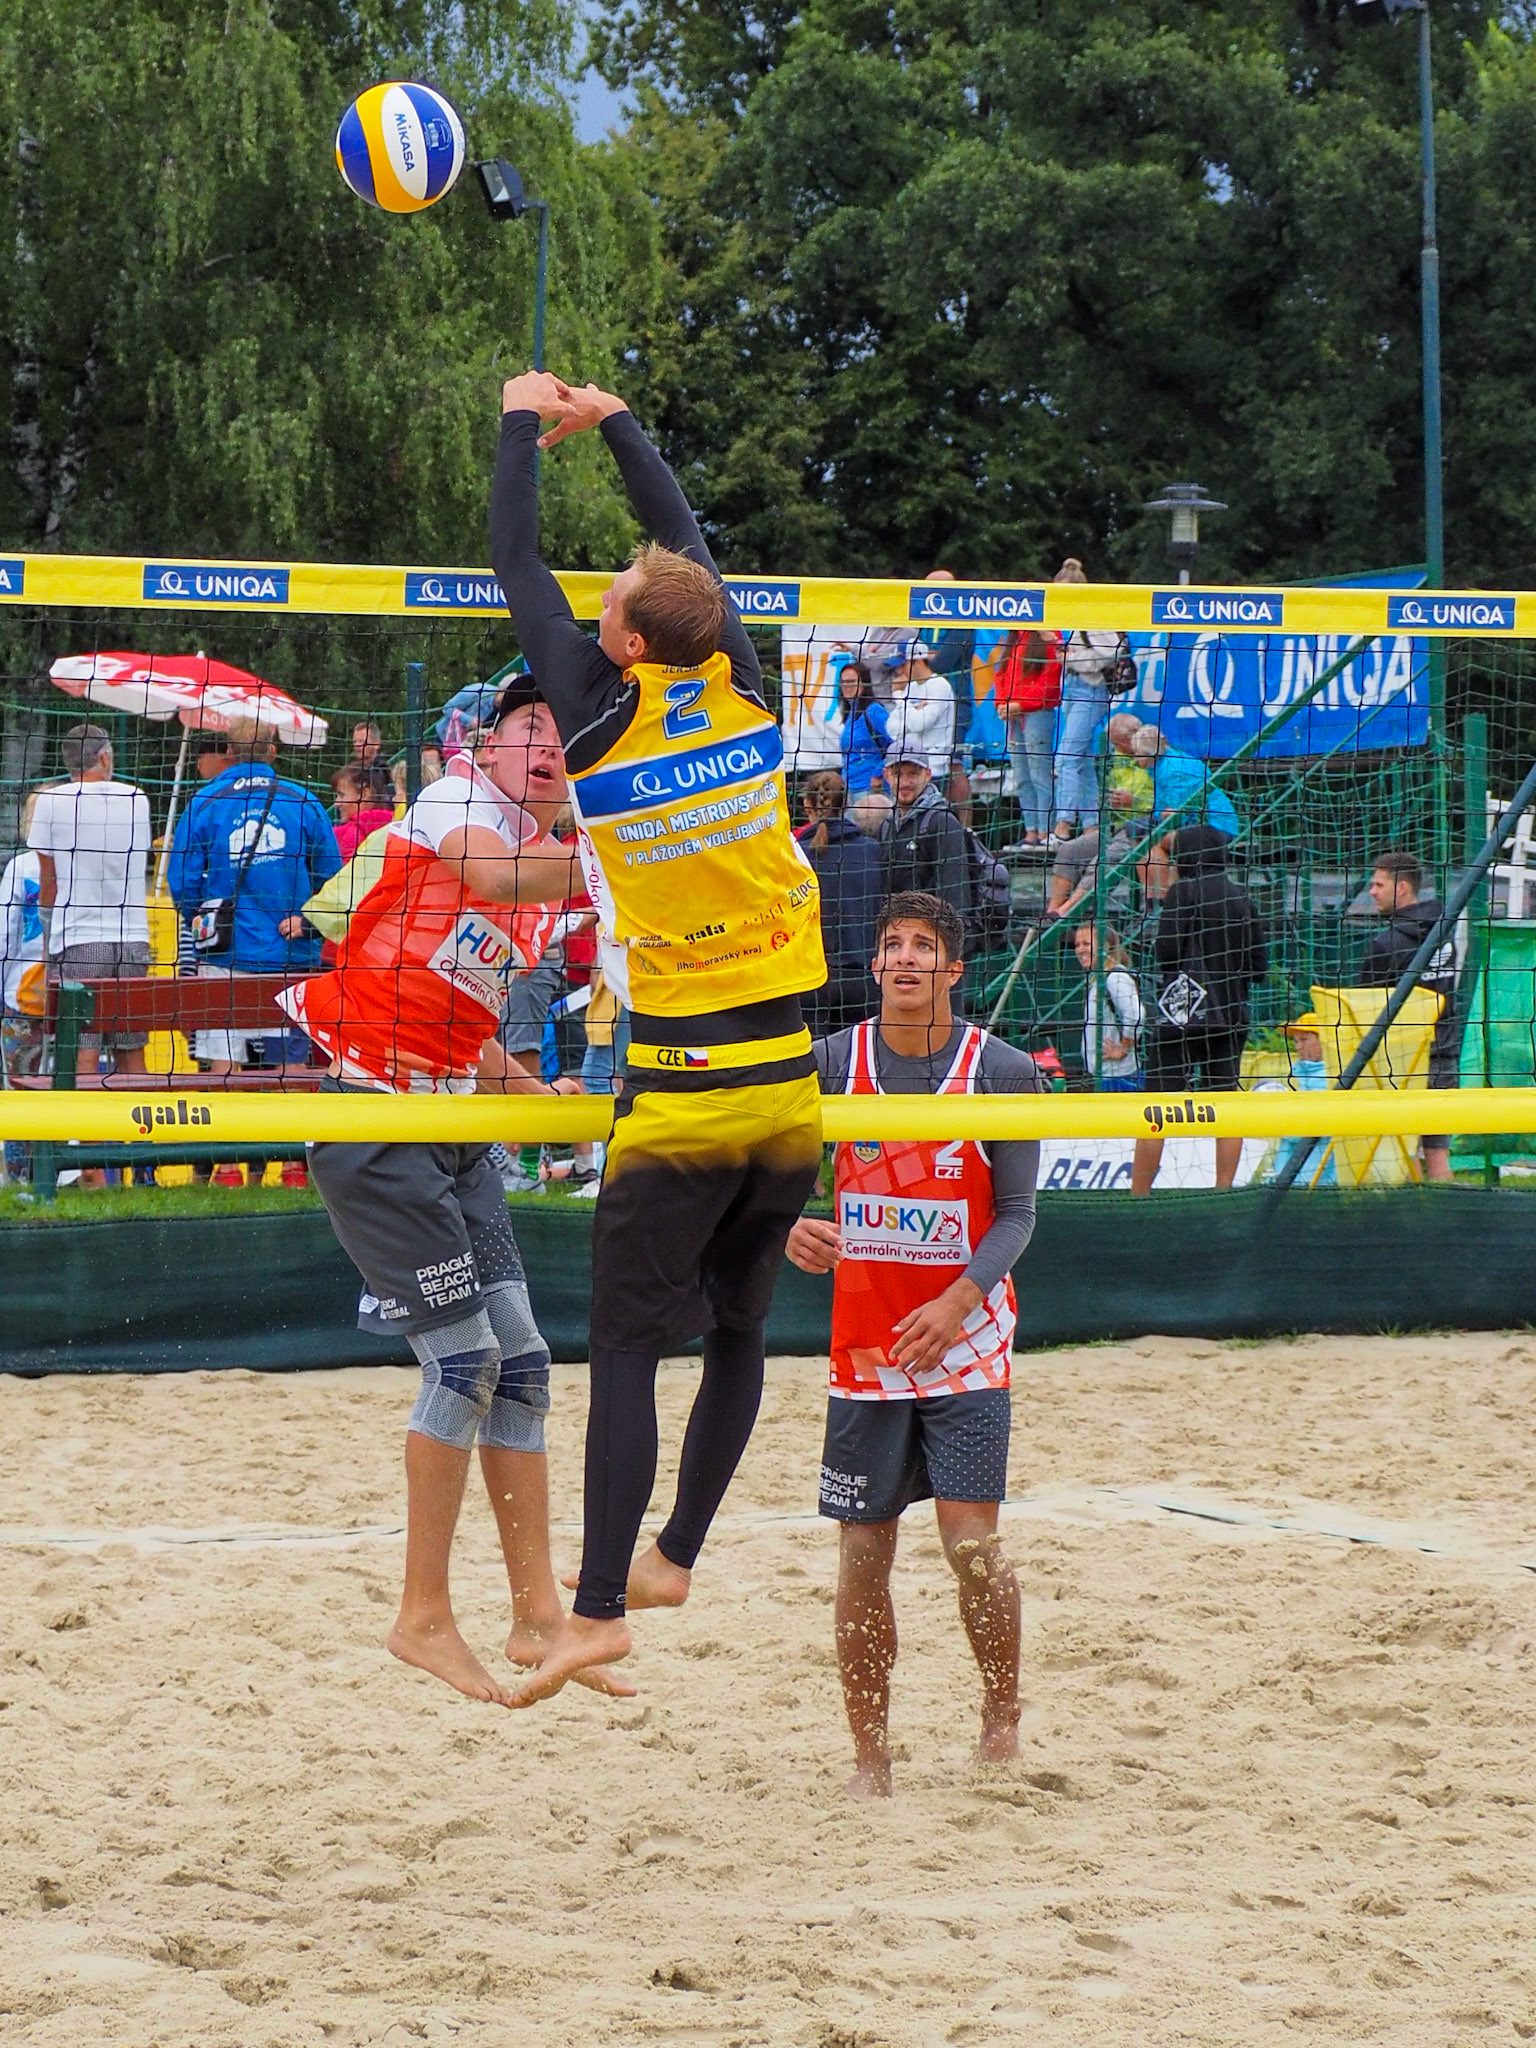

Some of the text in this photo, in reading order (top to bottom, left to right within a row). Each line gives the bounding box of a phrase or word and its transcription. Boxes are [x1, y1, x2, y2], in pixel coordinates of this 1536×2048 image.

[195, 574, 278, 598] UNIQA
[456, 582, 508, 604] UNI
[729, 589, 788, 612] NIQA
[957, 595, 1034, 618] UNIQA
[1198, 599, 1273, 621] UNIQA
[1432, 603, 1505, 625] UNIQA
[1258, 635, 1417, 718] UNIQA
[662, 678, 712, 740] 2
[673, 745, 764, 788] UNIQA
[615, 818, 668, 843] UNIQA
[624, 852, 634, 867] V
[636, 837, 704, 866] PLÁŽOVÉM
[684, 924, 726, 945] gala
[458, 921, 518, 984] HUSK
[743, 944, 762, 956] kraj
[657, 1048, 683, 1067] CZE
[131, 1099, 212, 1135] gala
[1143, 1099, 1216, 1133] gala
[935, 1165, 964, 1179] CZE
[1043, 1157, 1161, 1189] BEAC
[845, 1201, 938, 1242] HUSKY
[845, 1241, 961, 1261] Centrální vysavače
[415, 1251, 474, 1282] PRAGUE
[420, 1267, 474, 1296] BEACH
[424, 1284, 473, 1309] TEAM
[820, 1464, 868, 1487] PRAGUE
[818, 1478, 858, 1498] BEACH
